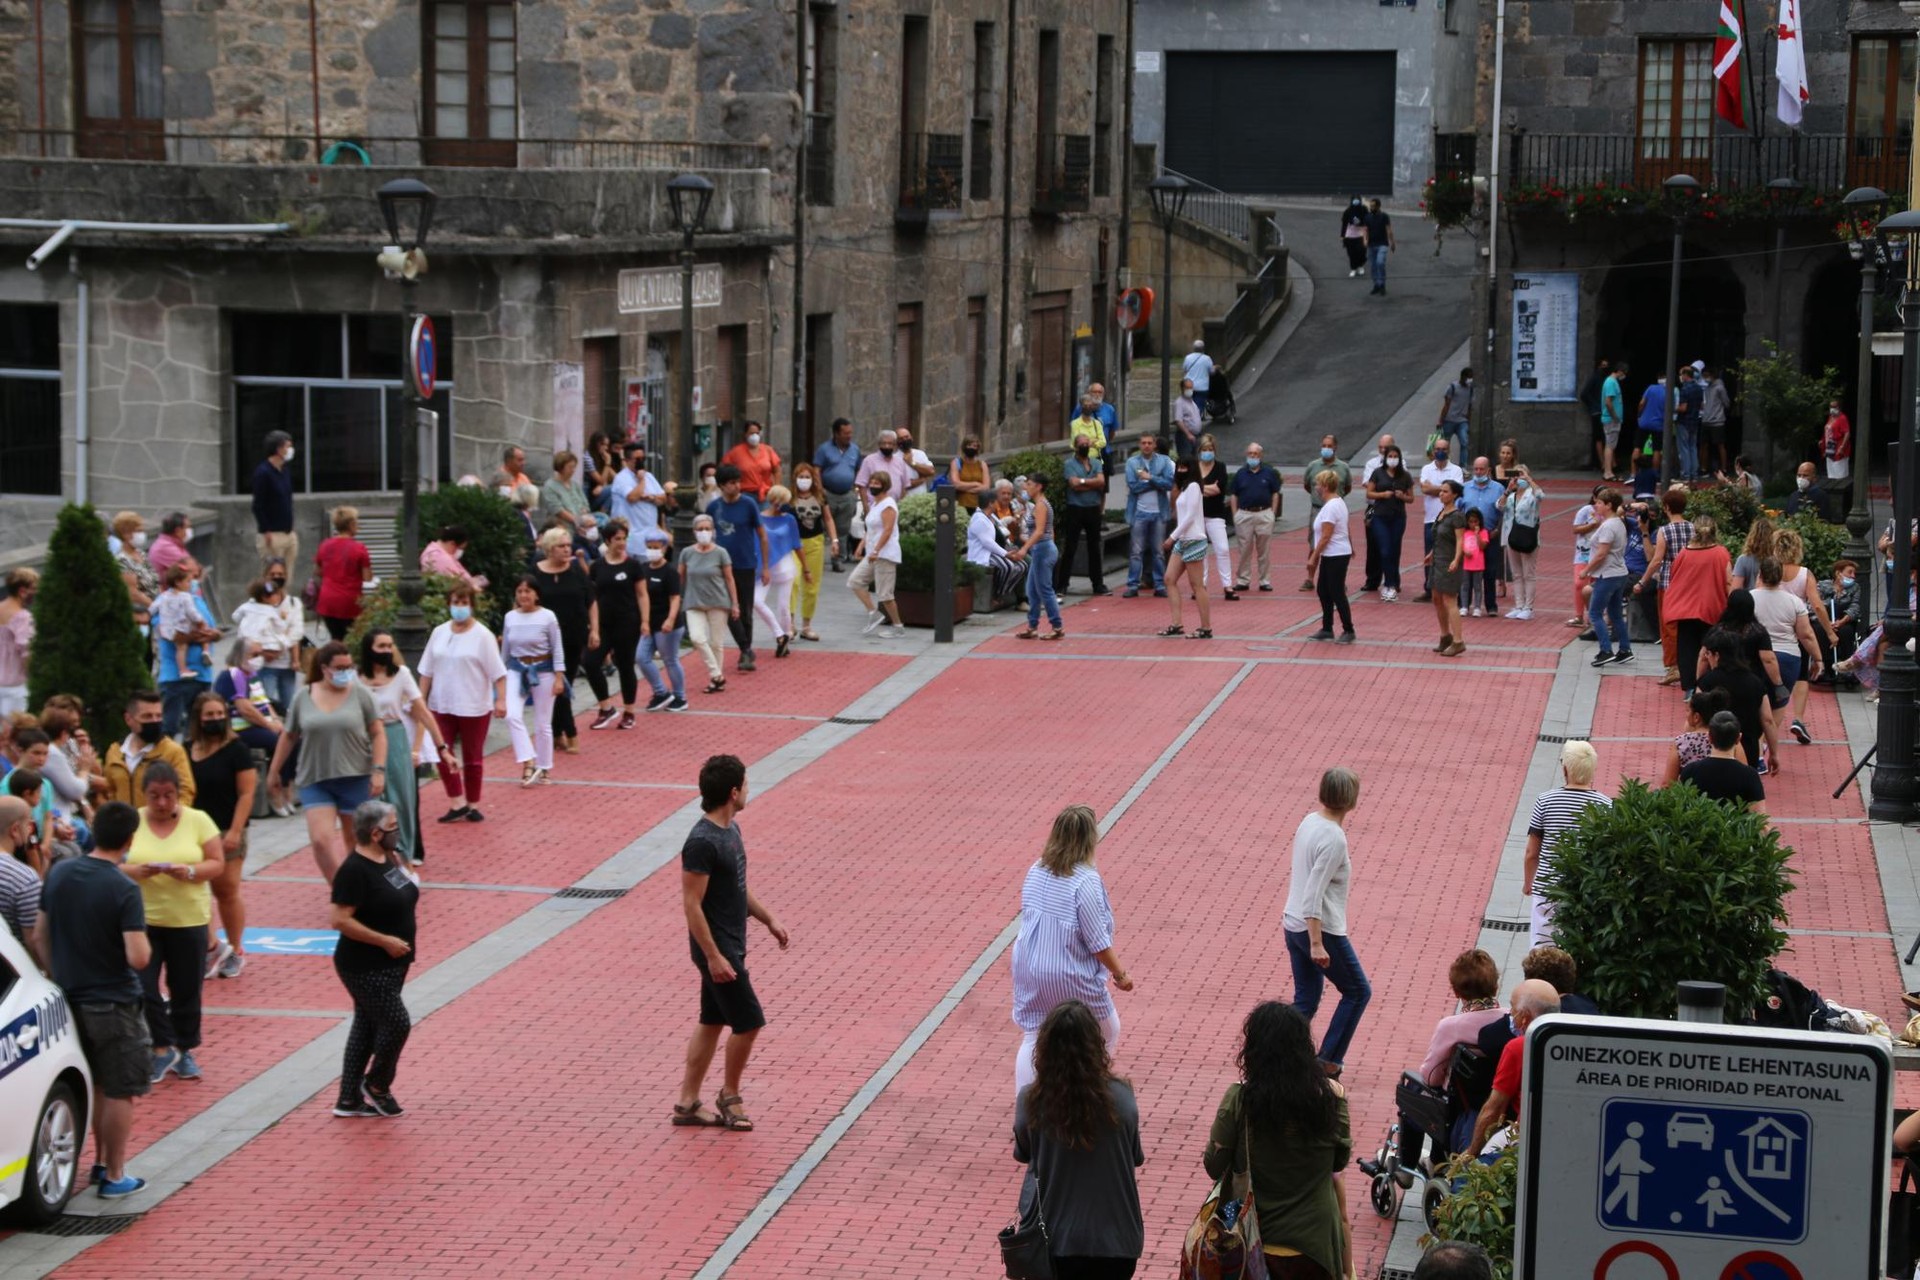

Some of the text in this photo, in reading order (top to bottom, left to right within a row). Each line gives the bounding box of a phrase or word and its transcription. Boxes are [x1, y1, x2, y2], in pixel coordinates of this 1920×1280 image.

[620, 269, 721, 306] JUVENTUD GZAGA
[1550, 1045, 1871, 1082] OINEZKOEK DUTE LEHENTASUNA
[1576, 1068, 1845, 1102] ÁREA DE PRIORIDAD PEATONAL
